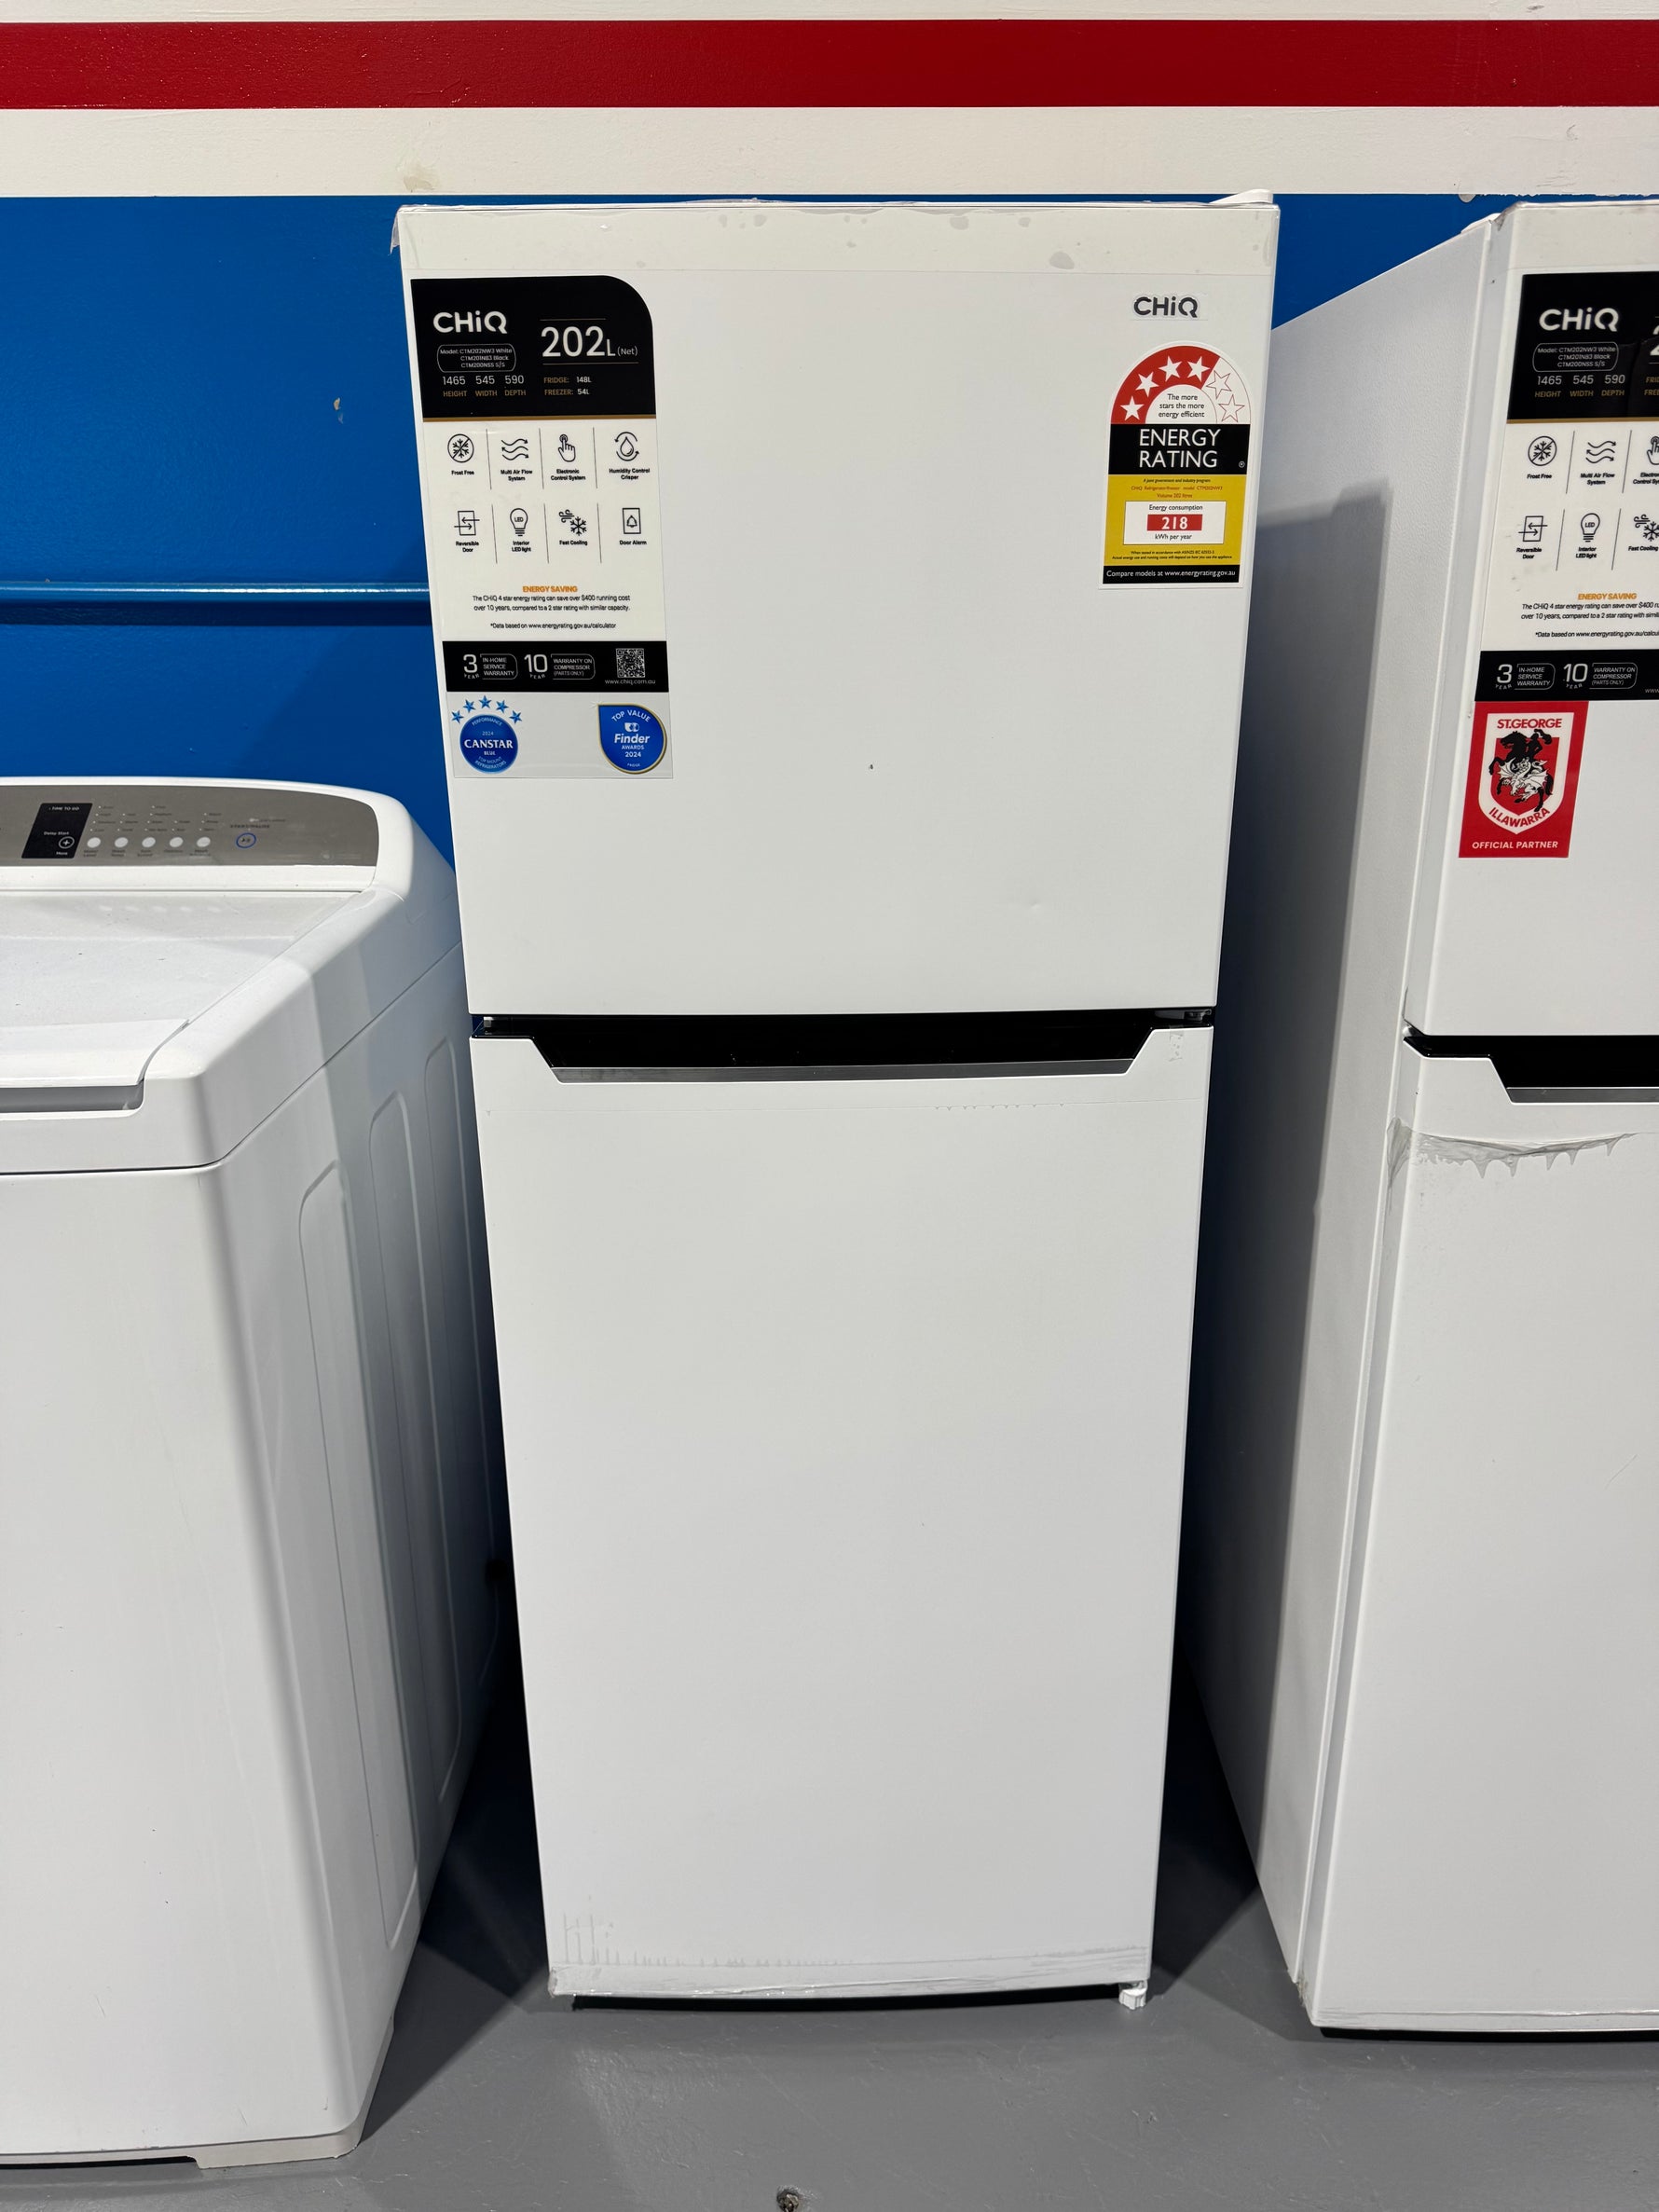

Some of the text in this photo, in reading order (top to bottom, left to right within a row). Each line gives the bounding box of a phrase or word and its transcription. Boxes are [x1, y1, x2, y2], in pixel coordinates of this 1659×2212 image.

[1133, 296, 1198, 318] CHiQ
[433, 310, 508, 334] CHiQ
[1539, 307, 1619, 332] CHiQ
[617, 346, 638, 356] (Net)
[442, 375, 525, 385] 1465 545 590
[1538, 374, 1625, 385] 1465 545 590
[1139, 428, 1221, 447] ENERGY
[1139, 450, 1217, 468] RATING
[1161, 516, 1187, 530] 218
[1106, 570, 1133, 578] Compare
[463, 653, 478, 673] 3
[524, 653, 548, 673] 10
[1497, 664, 1513, 683] 3
[1563, 663, 1588, 682] 10
[611, 709, 651, 722] TOP VALUE
[1497, 719, 1562, 729] ST.GEORGE
[464, 739, 514, 749] CANSTAR
[614, 733, 651, 744] Finder
[1488, 807, 1550, 827] ILLAWARRA
